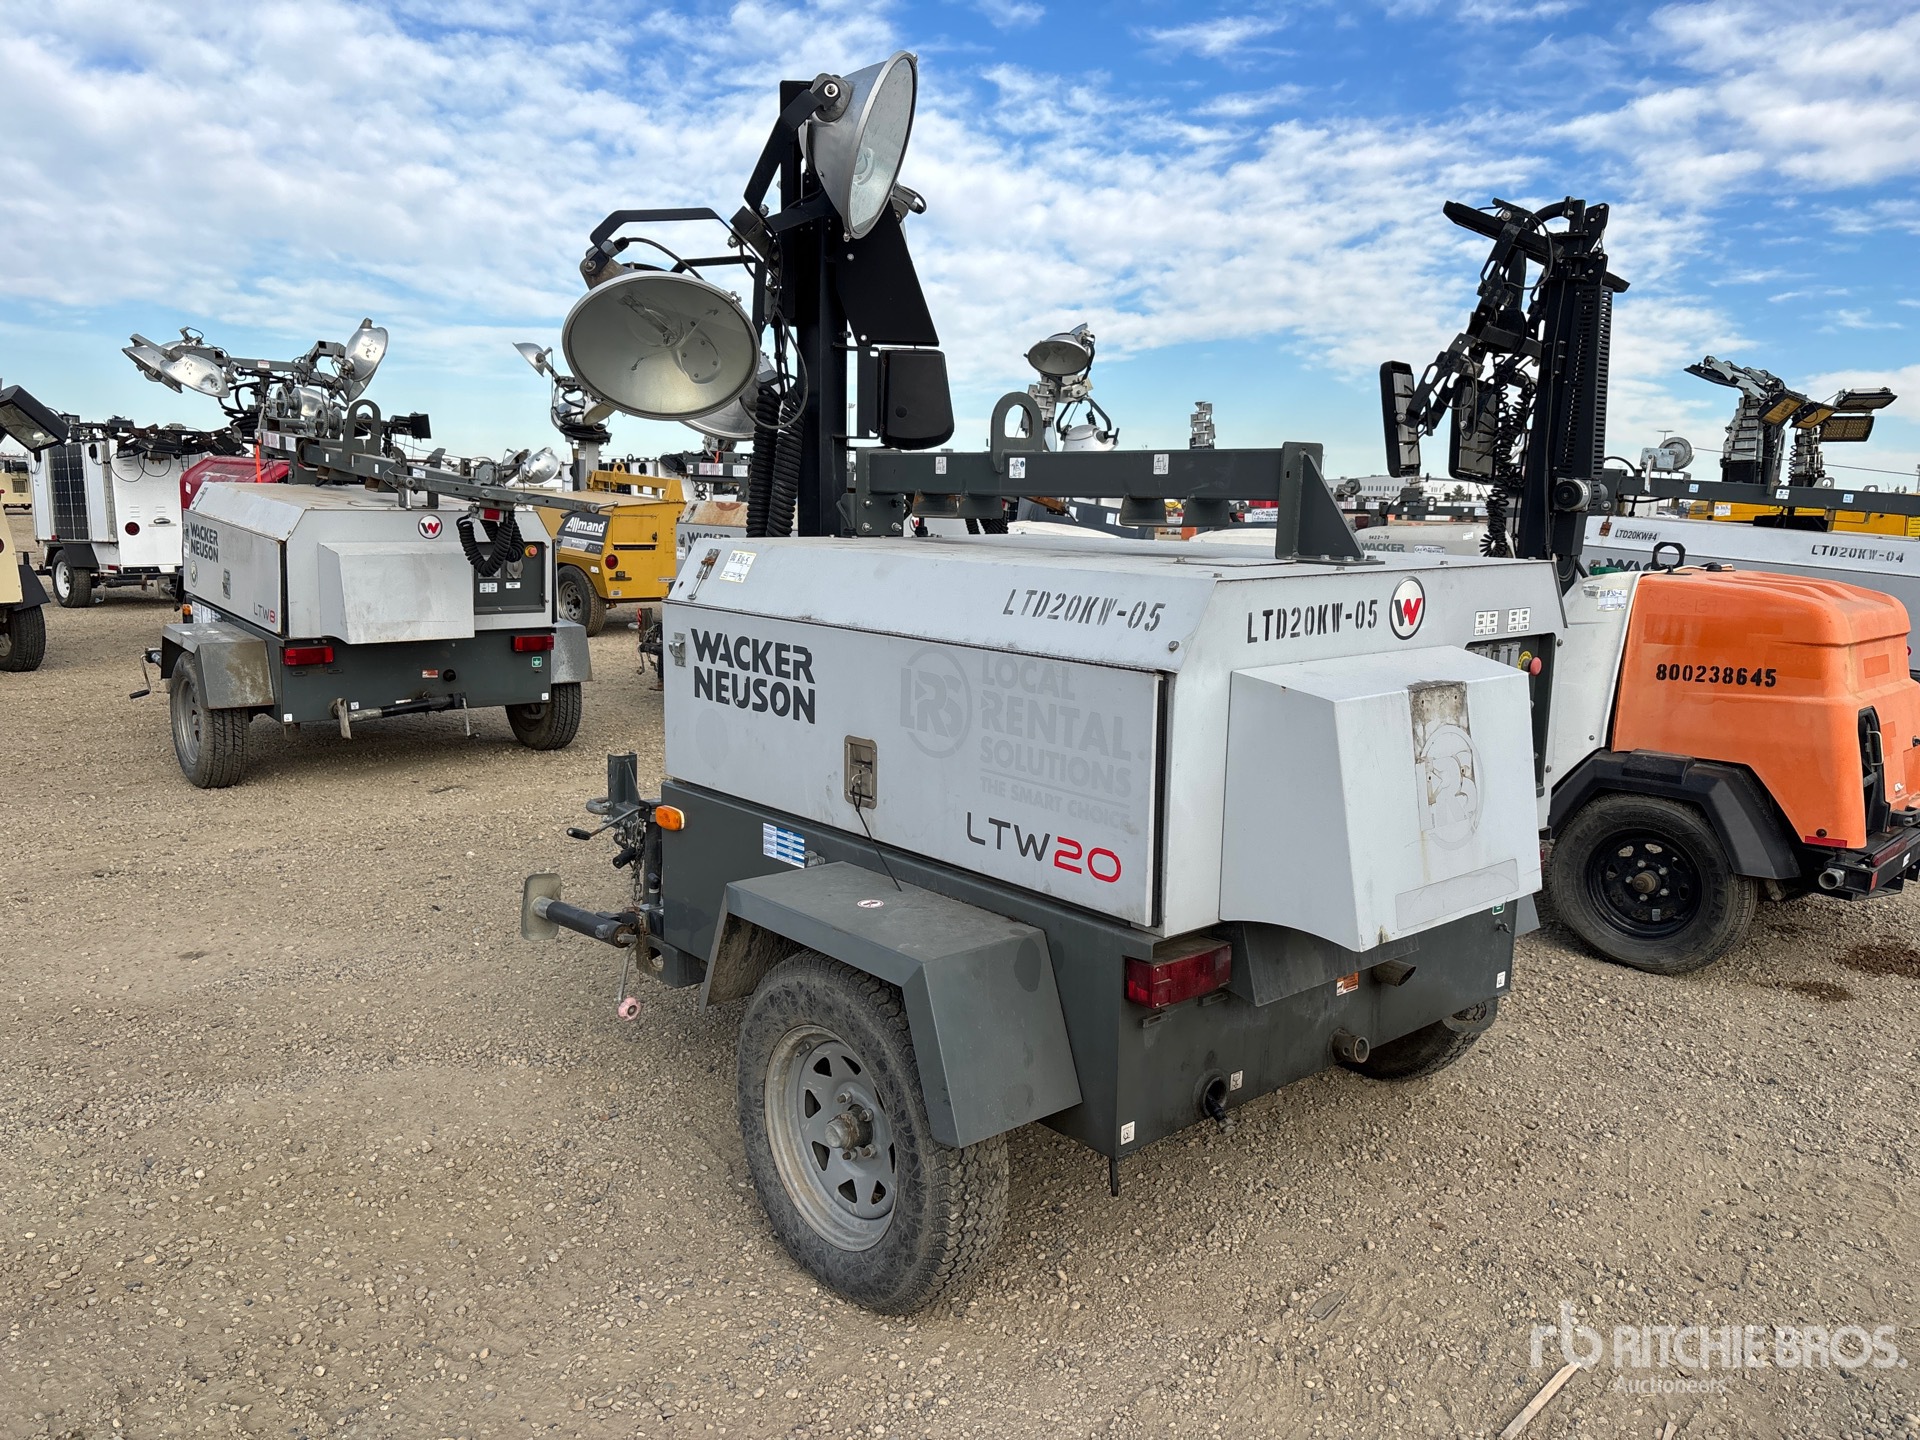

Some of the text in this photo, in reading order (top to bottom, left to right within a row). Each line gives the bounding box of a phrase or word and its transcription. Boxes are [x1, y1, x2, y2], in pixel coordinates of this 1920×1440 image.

[190, 521, 219, 547] WACKER
[565, 516, 606, 534] Allmand
[1361, 542, 1405, 552] WACKER
[1615, 529, 1658, 541] LTD20KW#4
[190, 539, 219, 564] NEUSON
[1811, 544, 1905, 563] LTD20KW-04
[1002, 588, 1166, 632] LTD20KW-05
[1247, 599, 1378, 644] LTD20KW-05
[690, 628, 816, 684] WACKER
[981, 653, 1076, 700] LOCAL
[1655, 663, 1777, 688] 800238645
[693, 665, 816, 724] NEUSON
[980, 689, 1131, 762] RENTAL
[980, 735, 1131, 798] SOLUTIONS
[980, 776, 1131, 829] THE SMART CHOICE
[967, 811, 1122, 883] LTW20
